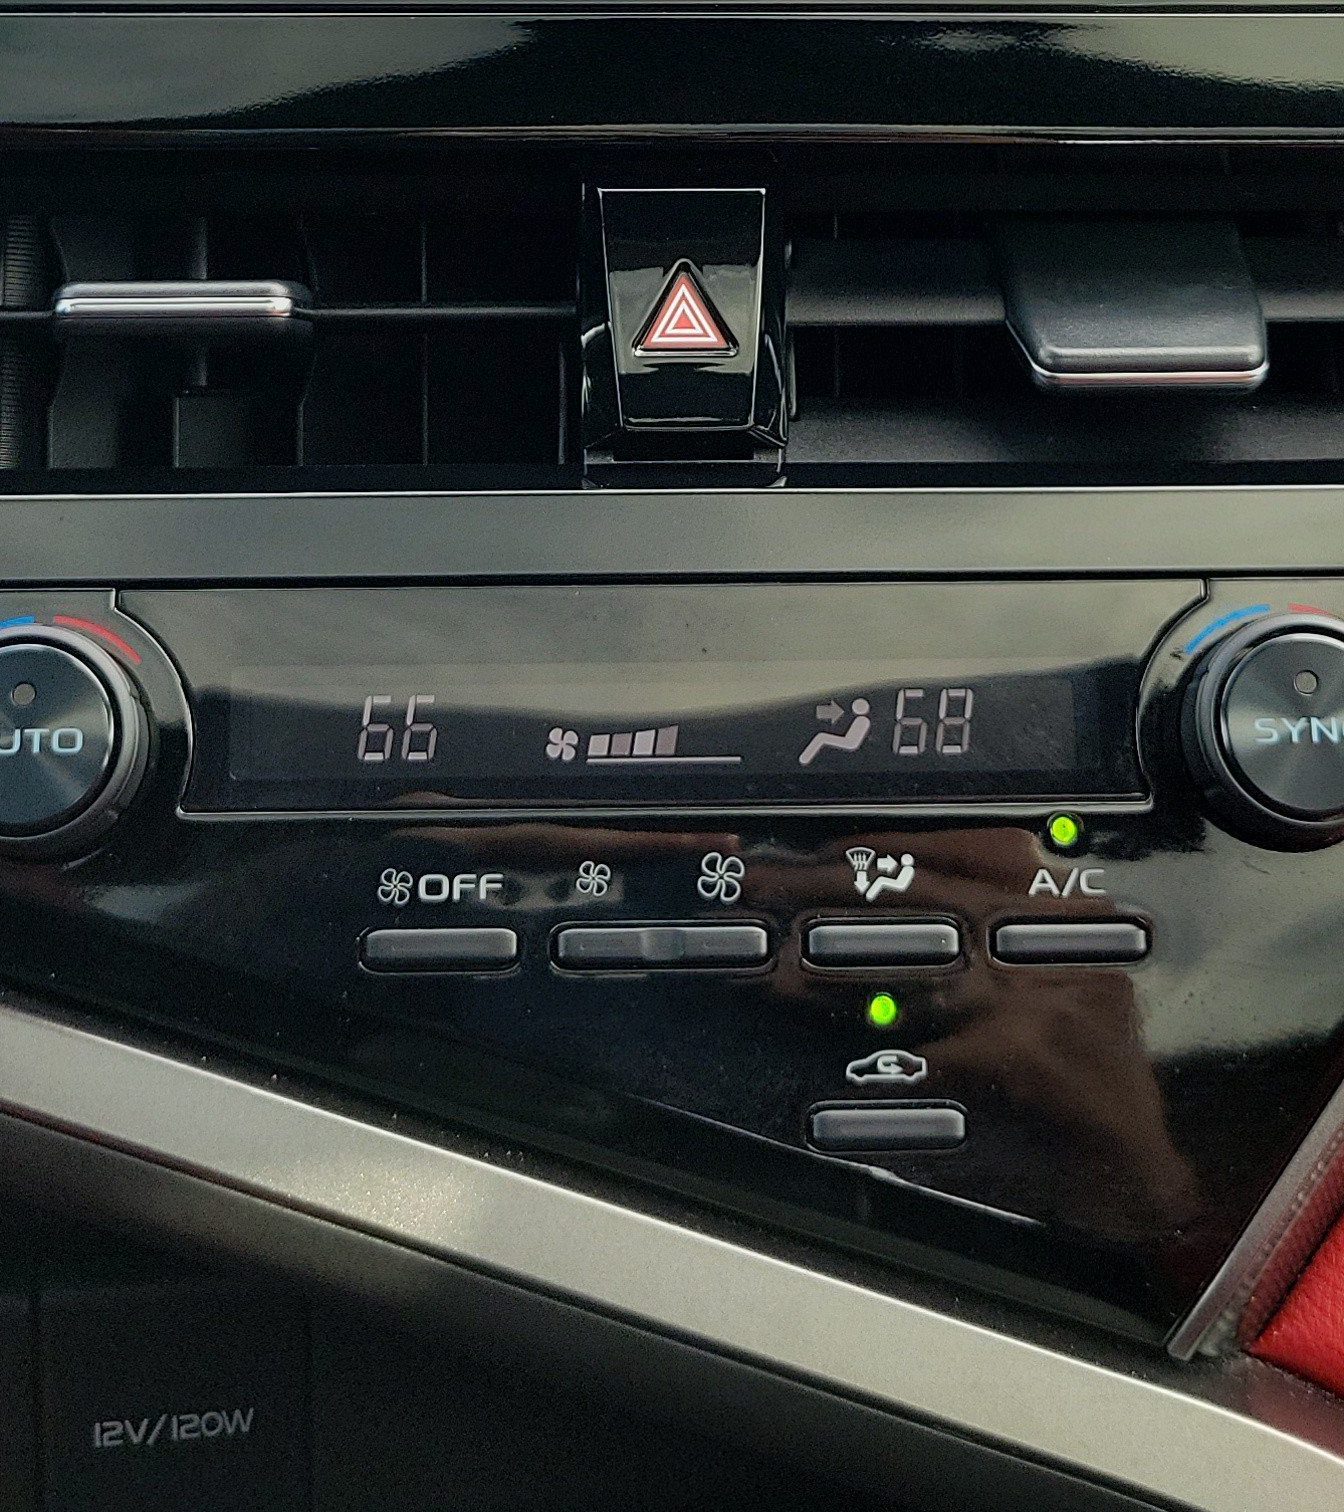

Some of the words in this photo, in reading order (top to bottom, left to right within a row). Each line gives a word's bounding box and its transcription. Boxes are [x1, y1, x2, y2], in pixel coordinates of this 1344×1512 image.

[356, 693, 439, 764] 66
[891, 687, 975, 757] 68
[417, 872, 505, 902] OFF
[1026, 865, 1108, 900] A/C
[92, 1406, 256, 1450] 12V/120W
